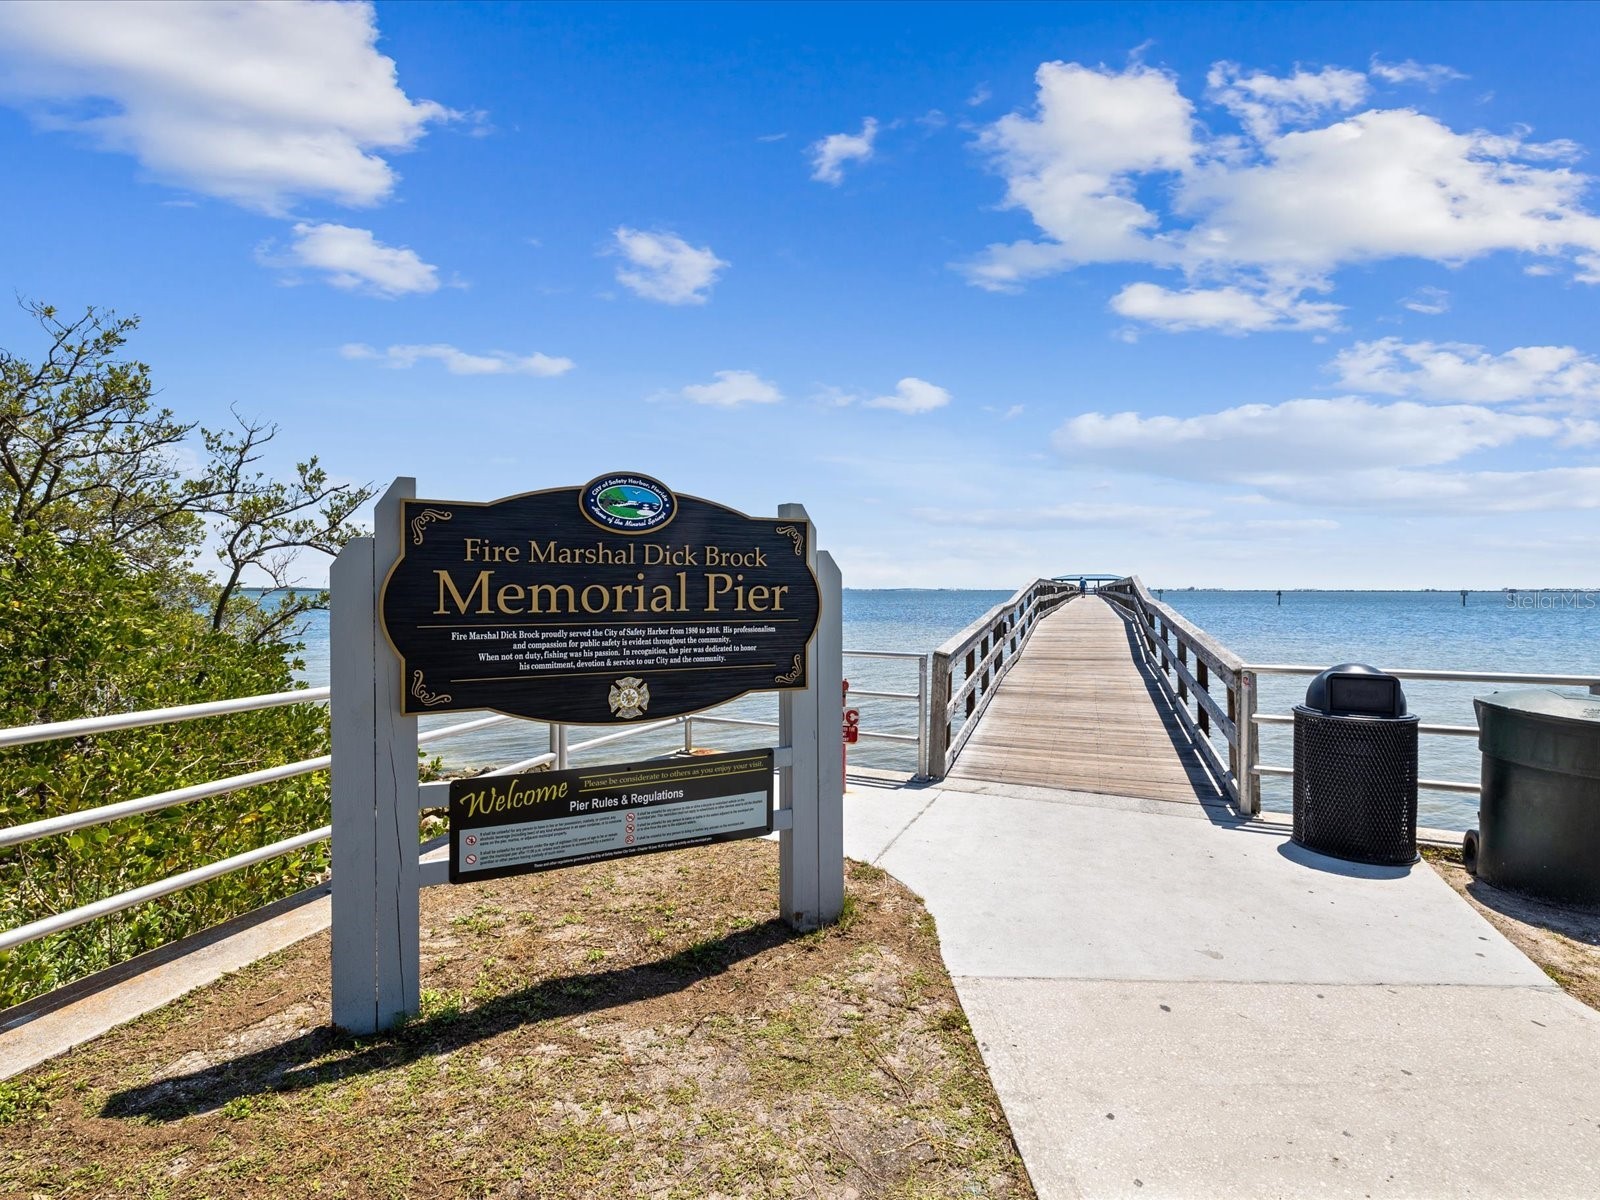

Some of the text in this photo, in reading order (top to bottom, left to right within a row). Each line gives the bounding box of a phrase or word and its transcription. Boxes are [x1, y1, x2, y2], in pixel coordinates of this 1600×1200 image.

[592, 486, 602, 496] City
[650, 484, 668, 502] Florida
[592, 506, 607, 519] Home
[648, 512, 666, 525] Springs
[464, 538, 768, 567] Fire Marshal Dick Brock
[433, 570, 788, 615] Memorial Pier
[452, 632, 467, 641] Fire
[469, 632, 499, 640] Marshal
[501, 632, 517, 640] Dick
[519, 631, 540, 639] Brock
[541, 630, 568, 640] proudly
[569, 630, 591, 638] served
[604, 629, 618, 639] City
[626, 629, 646, 638] Safety
[734, 626, 776, 636] professionalism
[513, 641, 526, 650] and
[528, 640, 567, 651] compassion
[580, 640, 600, 650] public
[602, 639, 621, 649] safety
[629, 638, 652, 646] evident
[652, 637, 686, 647] throughout
[698, 636, 732, 646] community.
[478, 653, 500, 662] When
[501, 652, 513, 661] not
[525, 651, 543, 662] duty,
[544, 651, 568, 661] fishing
[594, 649, 620, 659] passion.
[632, 647, 668, 658] recognition,
[679, 646, 692, 656] pier
[705, 645, 733, 653] dedicated
[520, 662, 530, 670] his
[531, 661, 576, 671] commitment,
[577, 659, 605, 668] devotion
[613, 658, 635, 667] service
[656, 657, 668, 667] City
[693, 655, 726, 665] community.
[584, 777, 608, 788] Please
[608, 776, 618, 785] be
[619, 772, 659, 784] considerate
[661, 771, 669, 779] to
[670, 768, 691, 778] others
[701, 768, 714, 776] you
[714, 766, 731, 775] enjoy
[733, 764, 748, 773] your
[460, 779, 568, 818] Welcome
[570, 790, 684, 812] Pier Rules & Regulations
